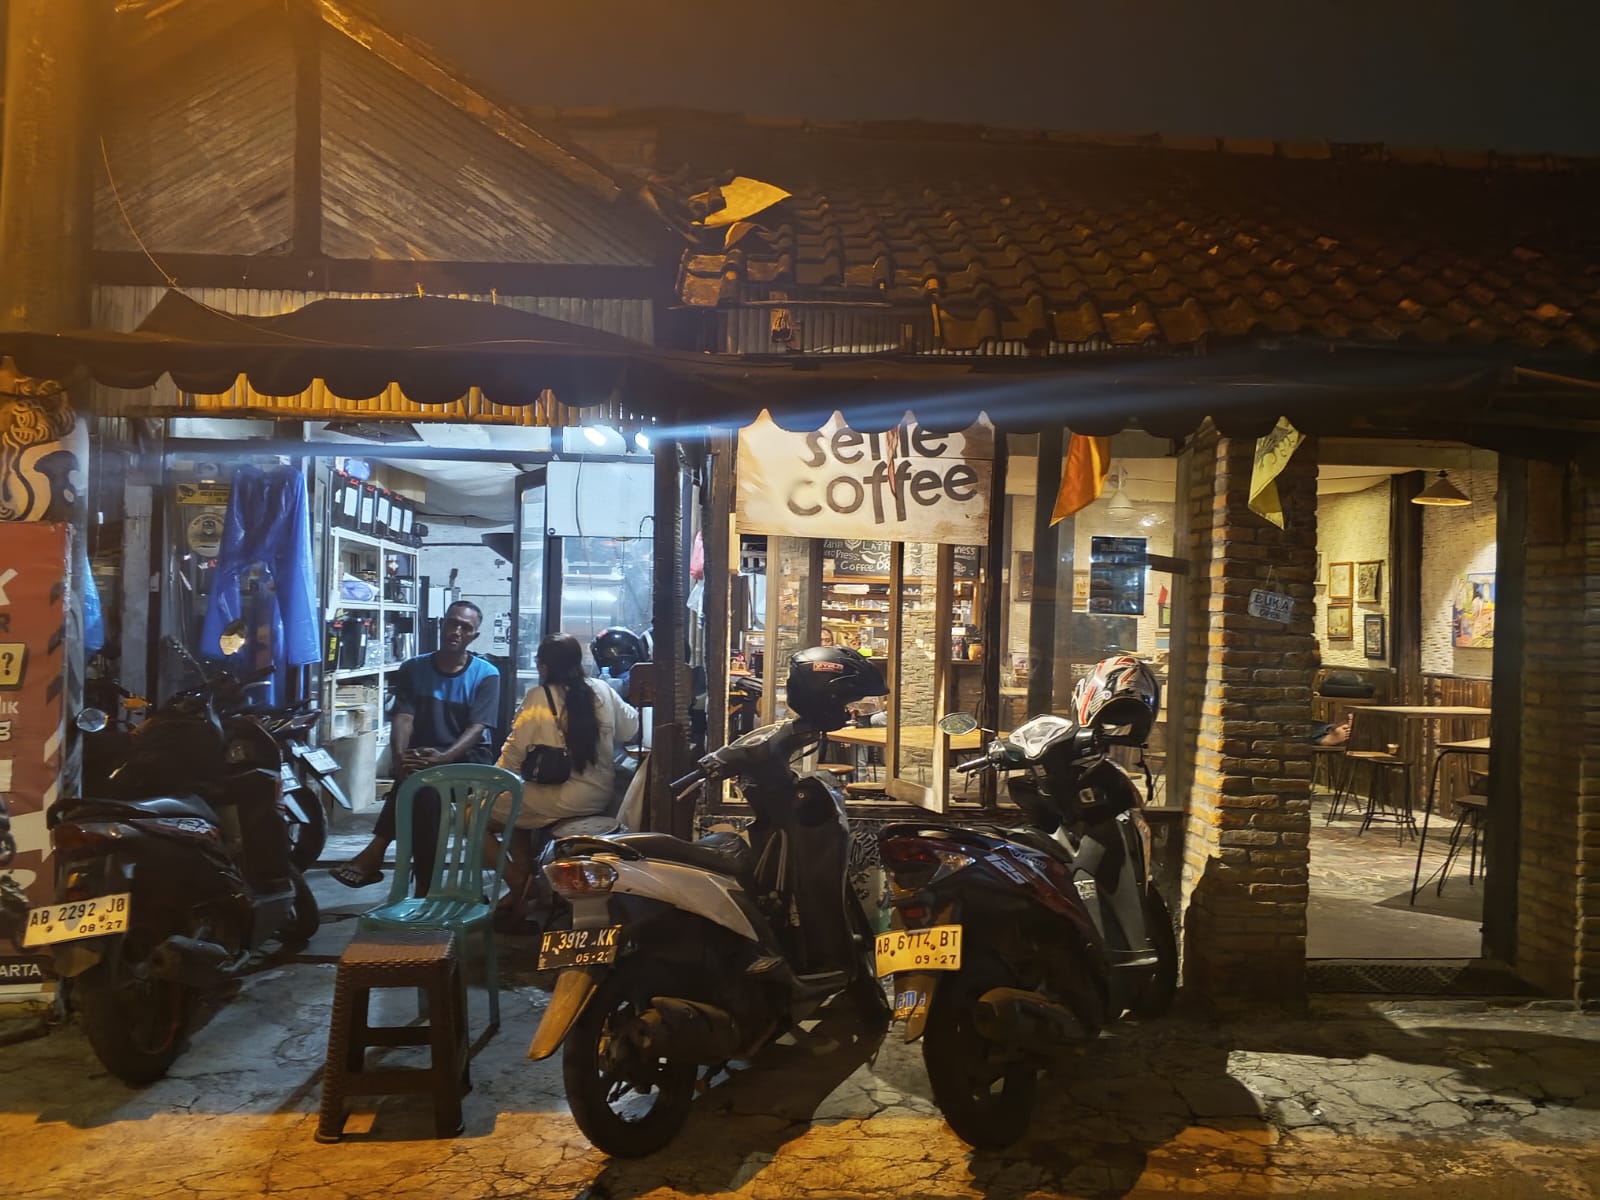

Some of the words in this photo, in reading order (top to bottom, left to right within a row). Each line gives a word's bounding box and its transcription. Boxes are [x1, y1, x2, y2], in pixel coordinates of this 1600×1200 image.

[787, 461, 978, 524] coffee
[1254, 594, 1289, 611] BUKA
[30, 910, 49, 927] AB
[58, 902, 96, 922] 2292
[541, 935, 551, 952] H
[558, 931, 588, 949] 3912
[597, 928, 617, 946] KK
[877, 938, 890, 956] AB
[940, 931, 958, 947] BT
